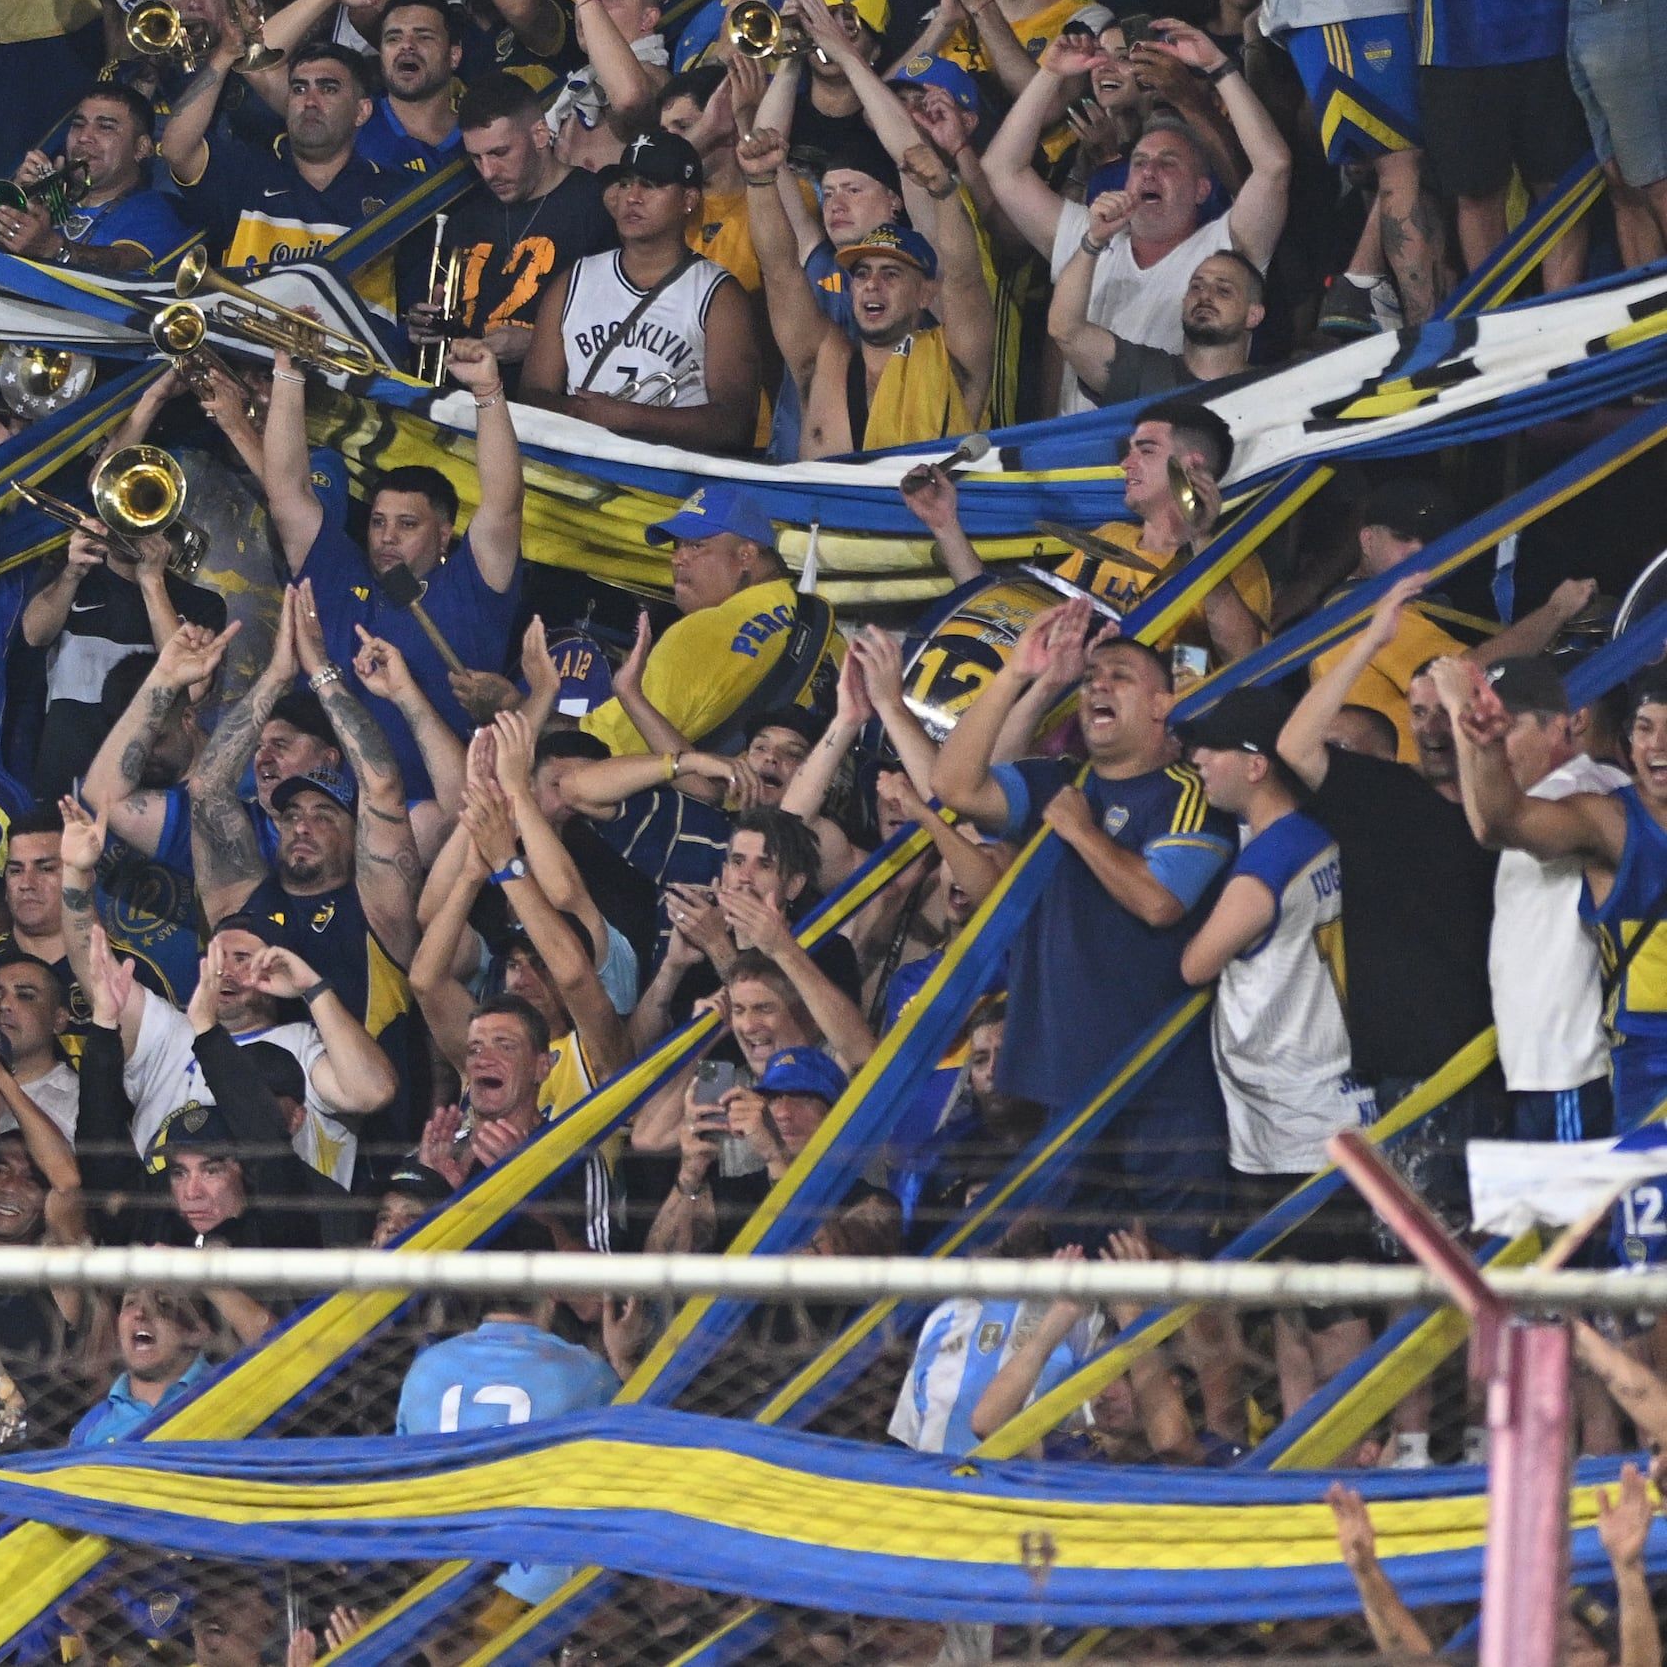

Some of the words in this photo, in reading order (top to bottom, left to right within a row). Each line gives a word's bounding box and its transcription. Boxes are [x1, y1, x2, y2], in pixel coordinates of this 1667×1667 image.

[461, 236, 556, 336] 12
[616, 366, 639, 392] 7
[908, 648, 992, 713] 12
[1622, 1186, 1667, 1235] 12
